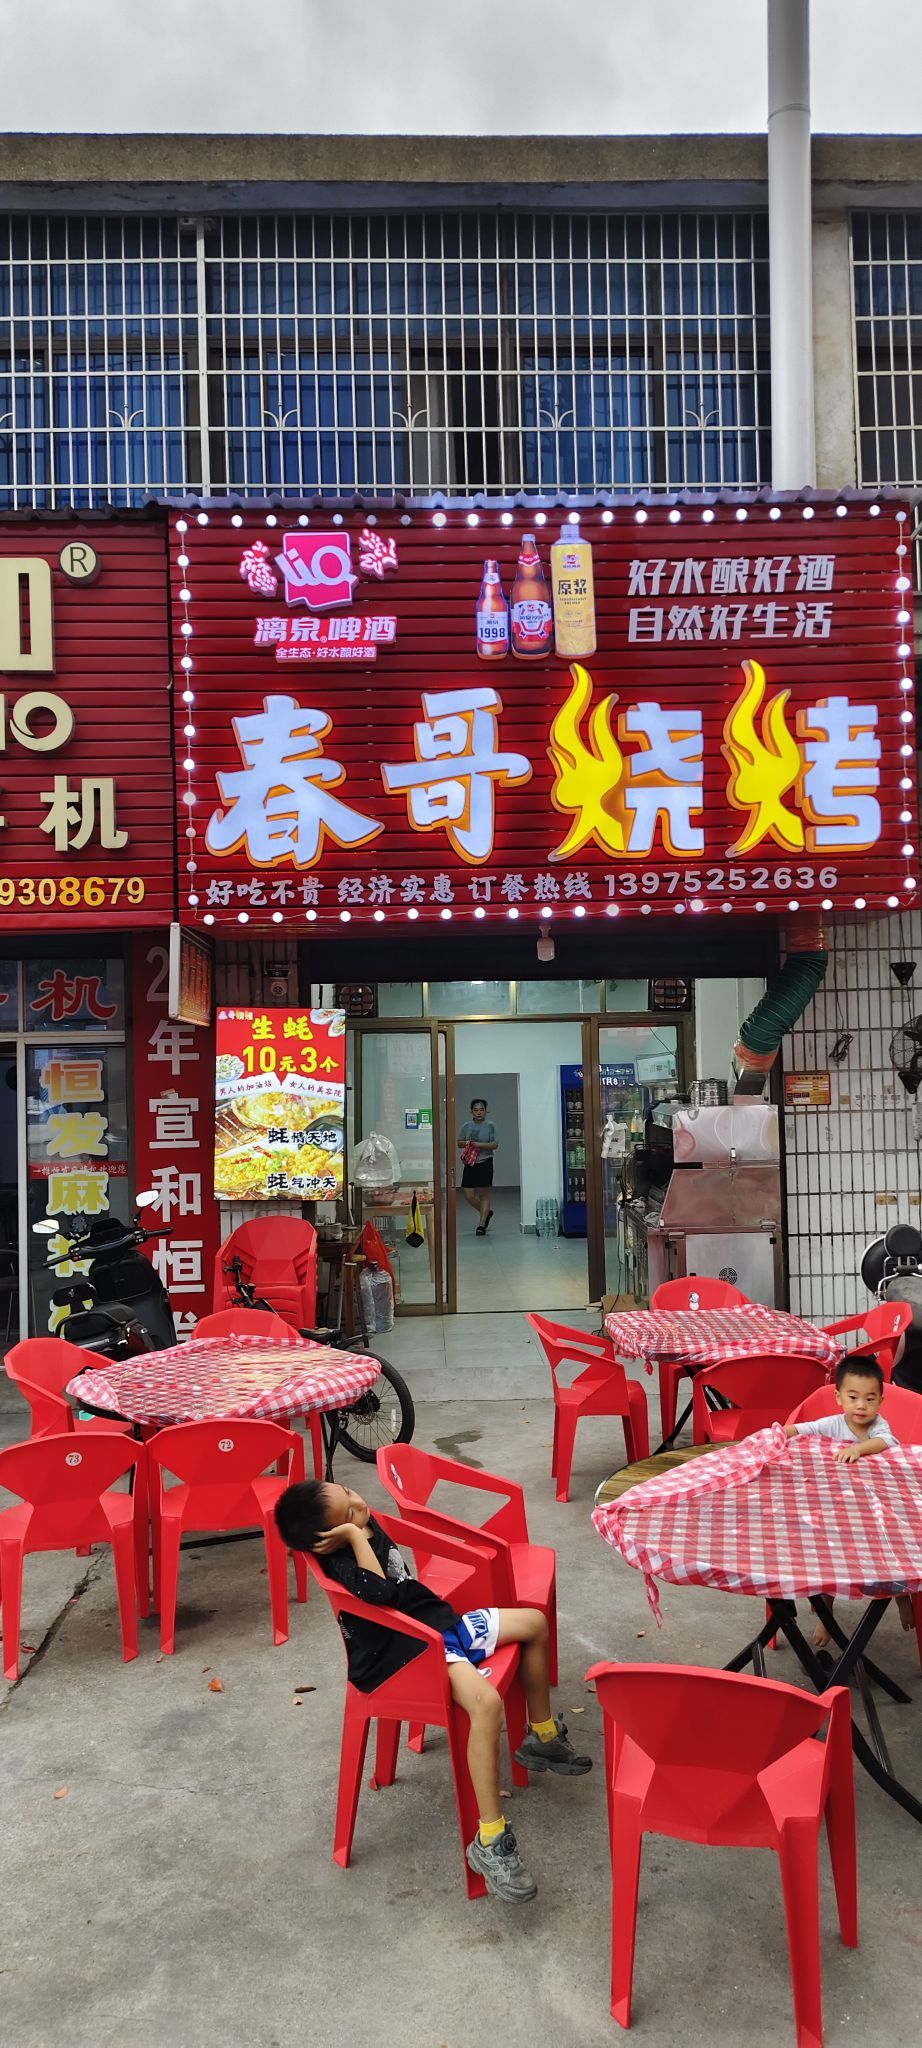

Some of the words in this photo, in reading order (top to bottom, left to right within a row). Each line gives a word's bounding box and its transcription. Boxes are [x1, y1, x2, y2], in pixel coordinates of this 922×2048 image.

[558, 579, 587, 595] 原浆
[628, 555, 836, 596] 好水酿好酒
[480, 627, 506, 638] 1998
[628, 602, 833, 642] 自然好生活
[206, 659, 884, 870] 春哥烧烤
[0, 775, 129, 852] 机
[0, 876, 145, 906] 9308679
[206, 875, 324, 906] 好吃不贵
[338, 873, 455, 904] 经济实惠
[468, 871, 593, 902] 订餐热线
[604, 866, 838, 898] 13975252636
[252, 1015, 313, 1041] 生蚝
[242, 1045, 339, 1073] 10元3个
[268, 1127, 337, 1145] 蚝情天地
[267, 1172, 336, 1190] 蚝气冲天
[220, 1440, 232, 1450] 72
[68, 1454, 80, 1464] 73
